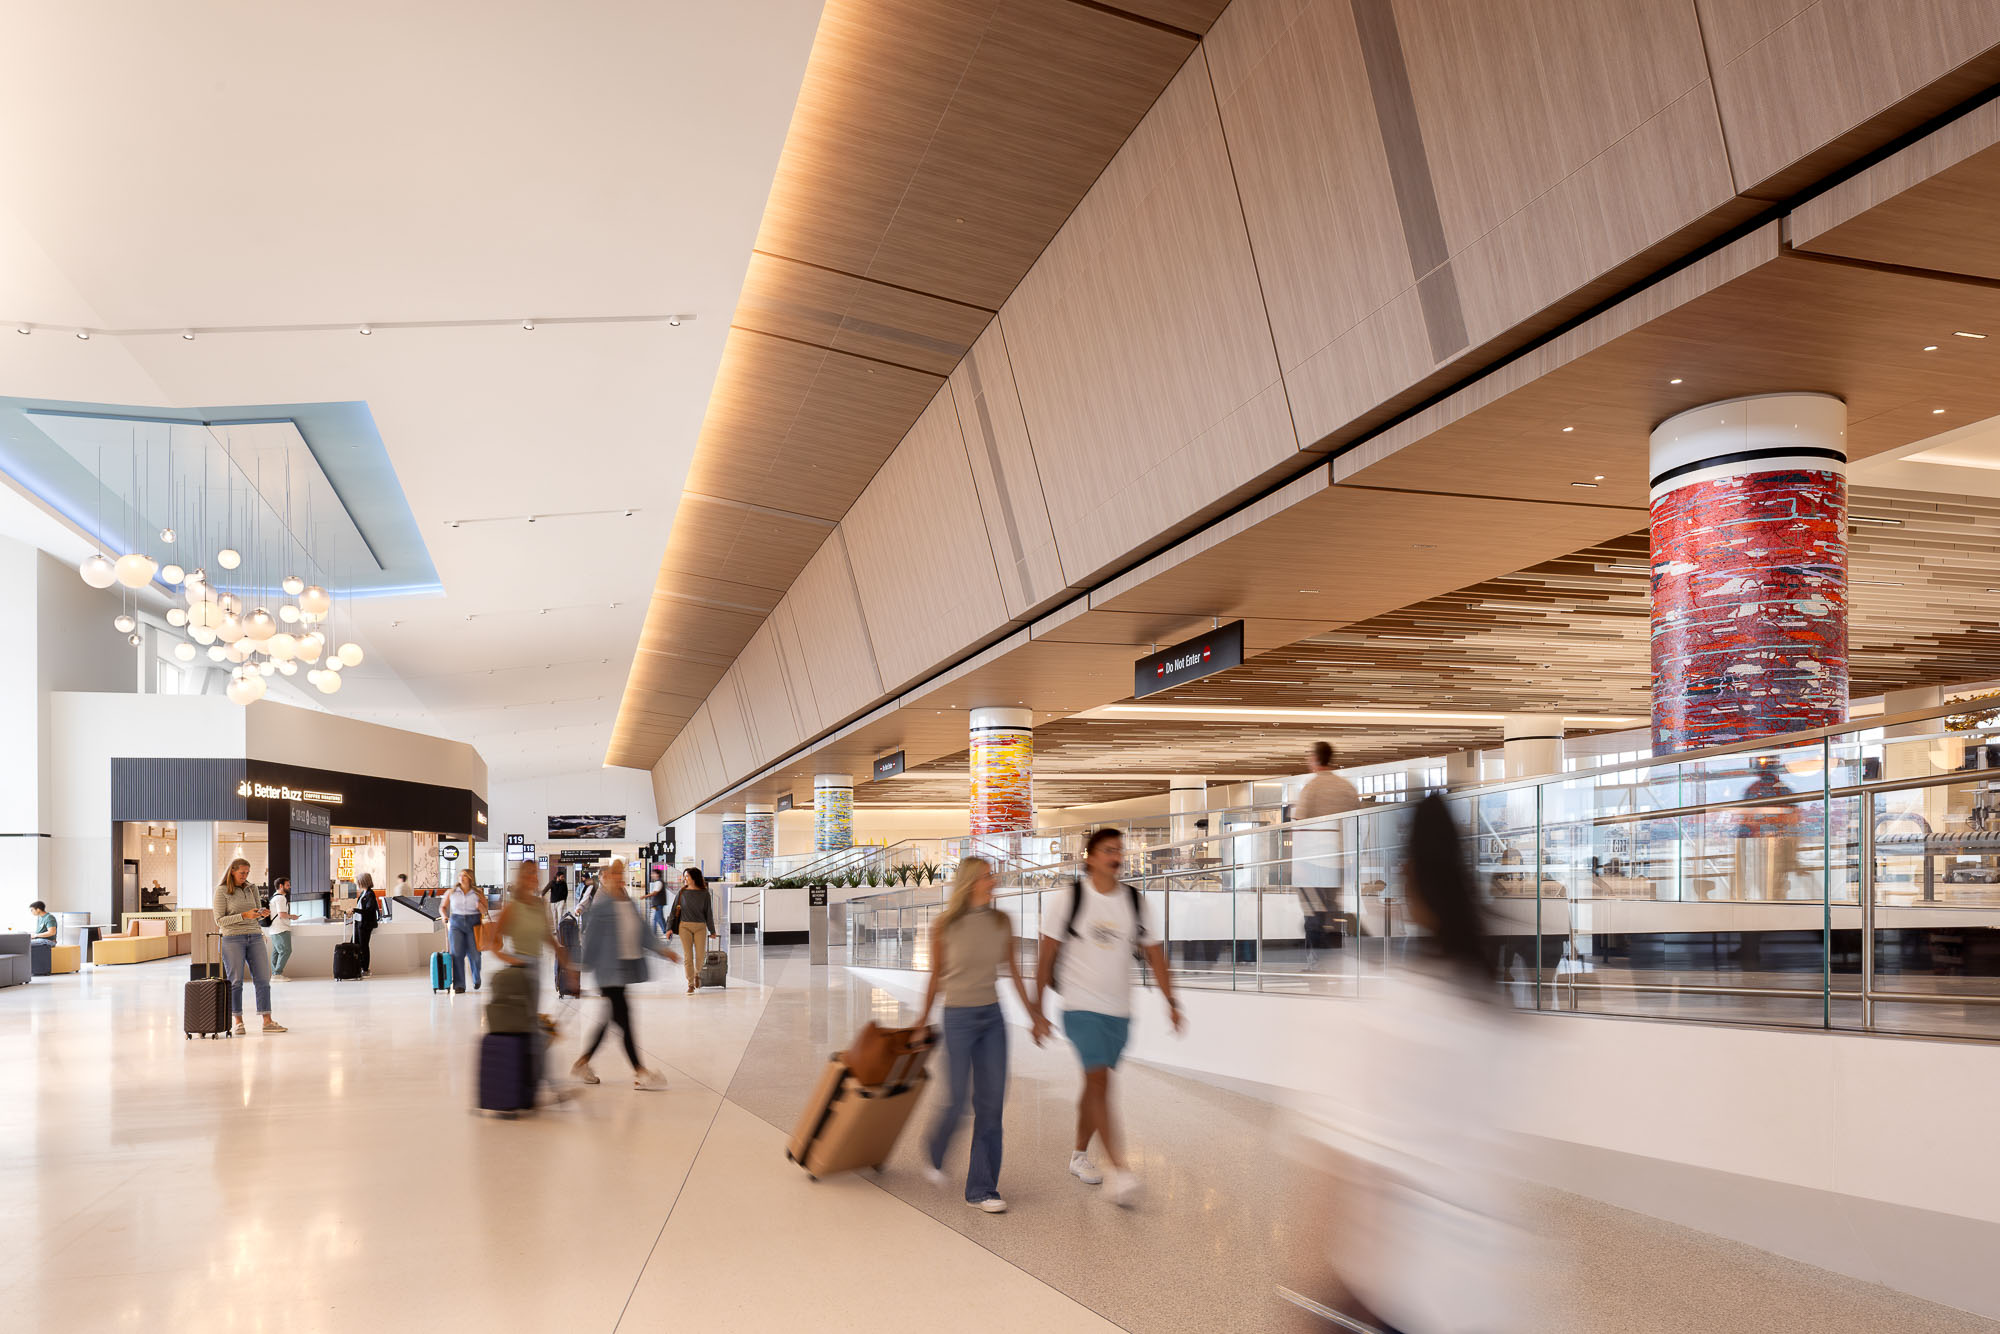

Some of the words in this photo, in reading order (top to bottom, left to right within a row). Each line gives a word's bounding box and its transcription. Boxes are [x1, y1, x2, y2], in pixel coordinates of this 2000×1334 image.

[1166, 662, 1174, 674] Do
[1174, 657, 1185, 671] Not
[1185, 653, 1201, 667] Enter
[254, 784, 281, 799] Better
[282, 786, 302, 801] Buzz
[508, 836, 523, 844] 119
